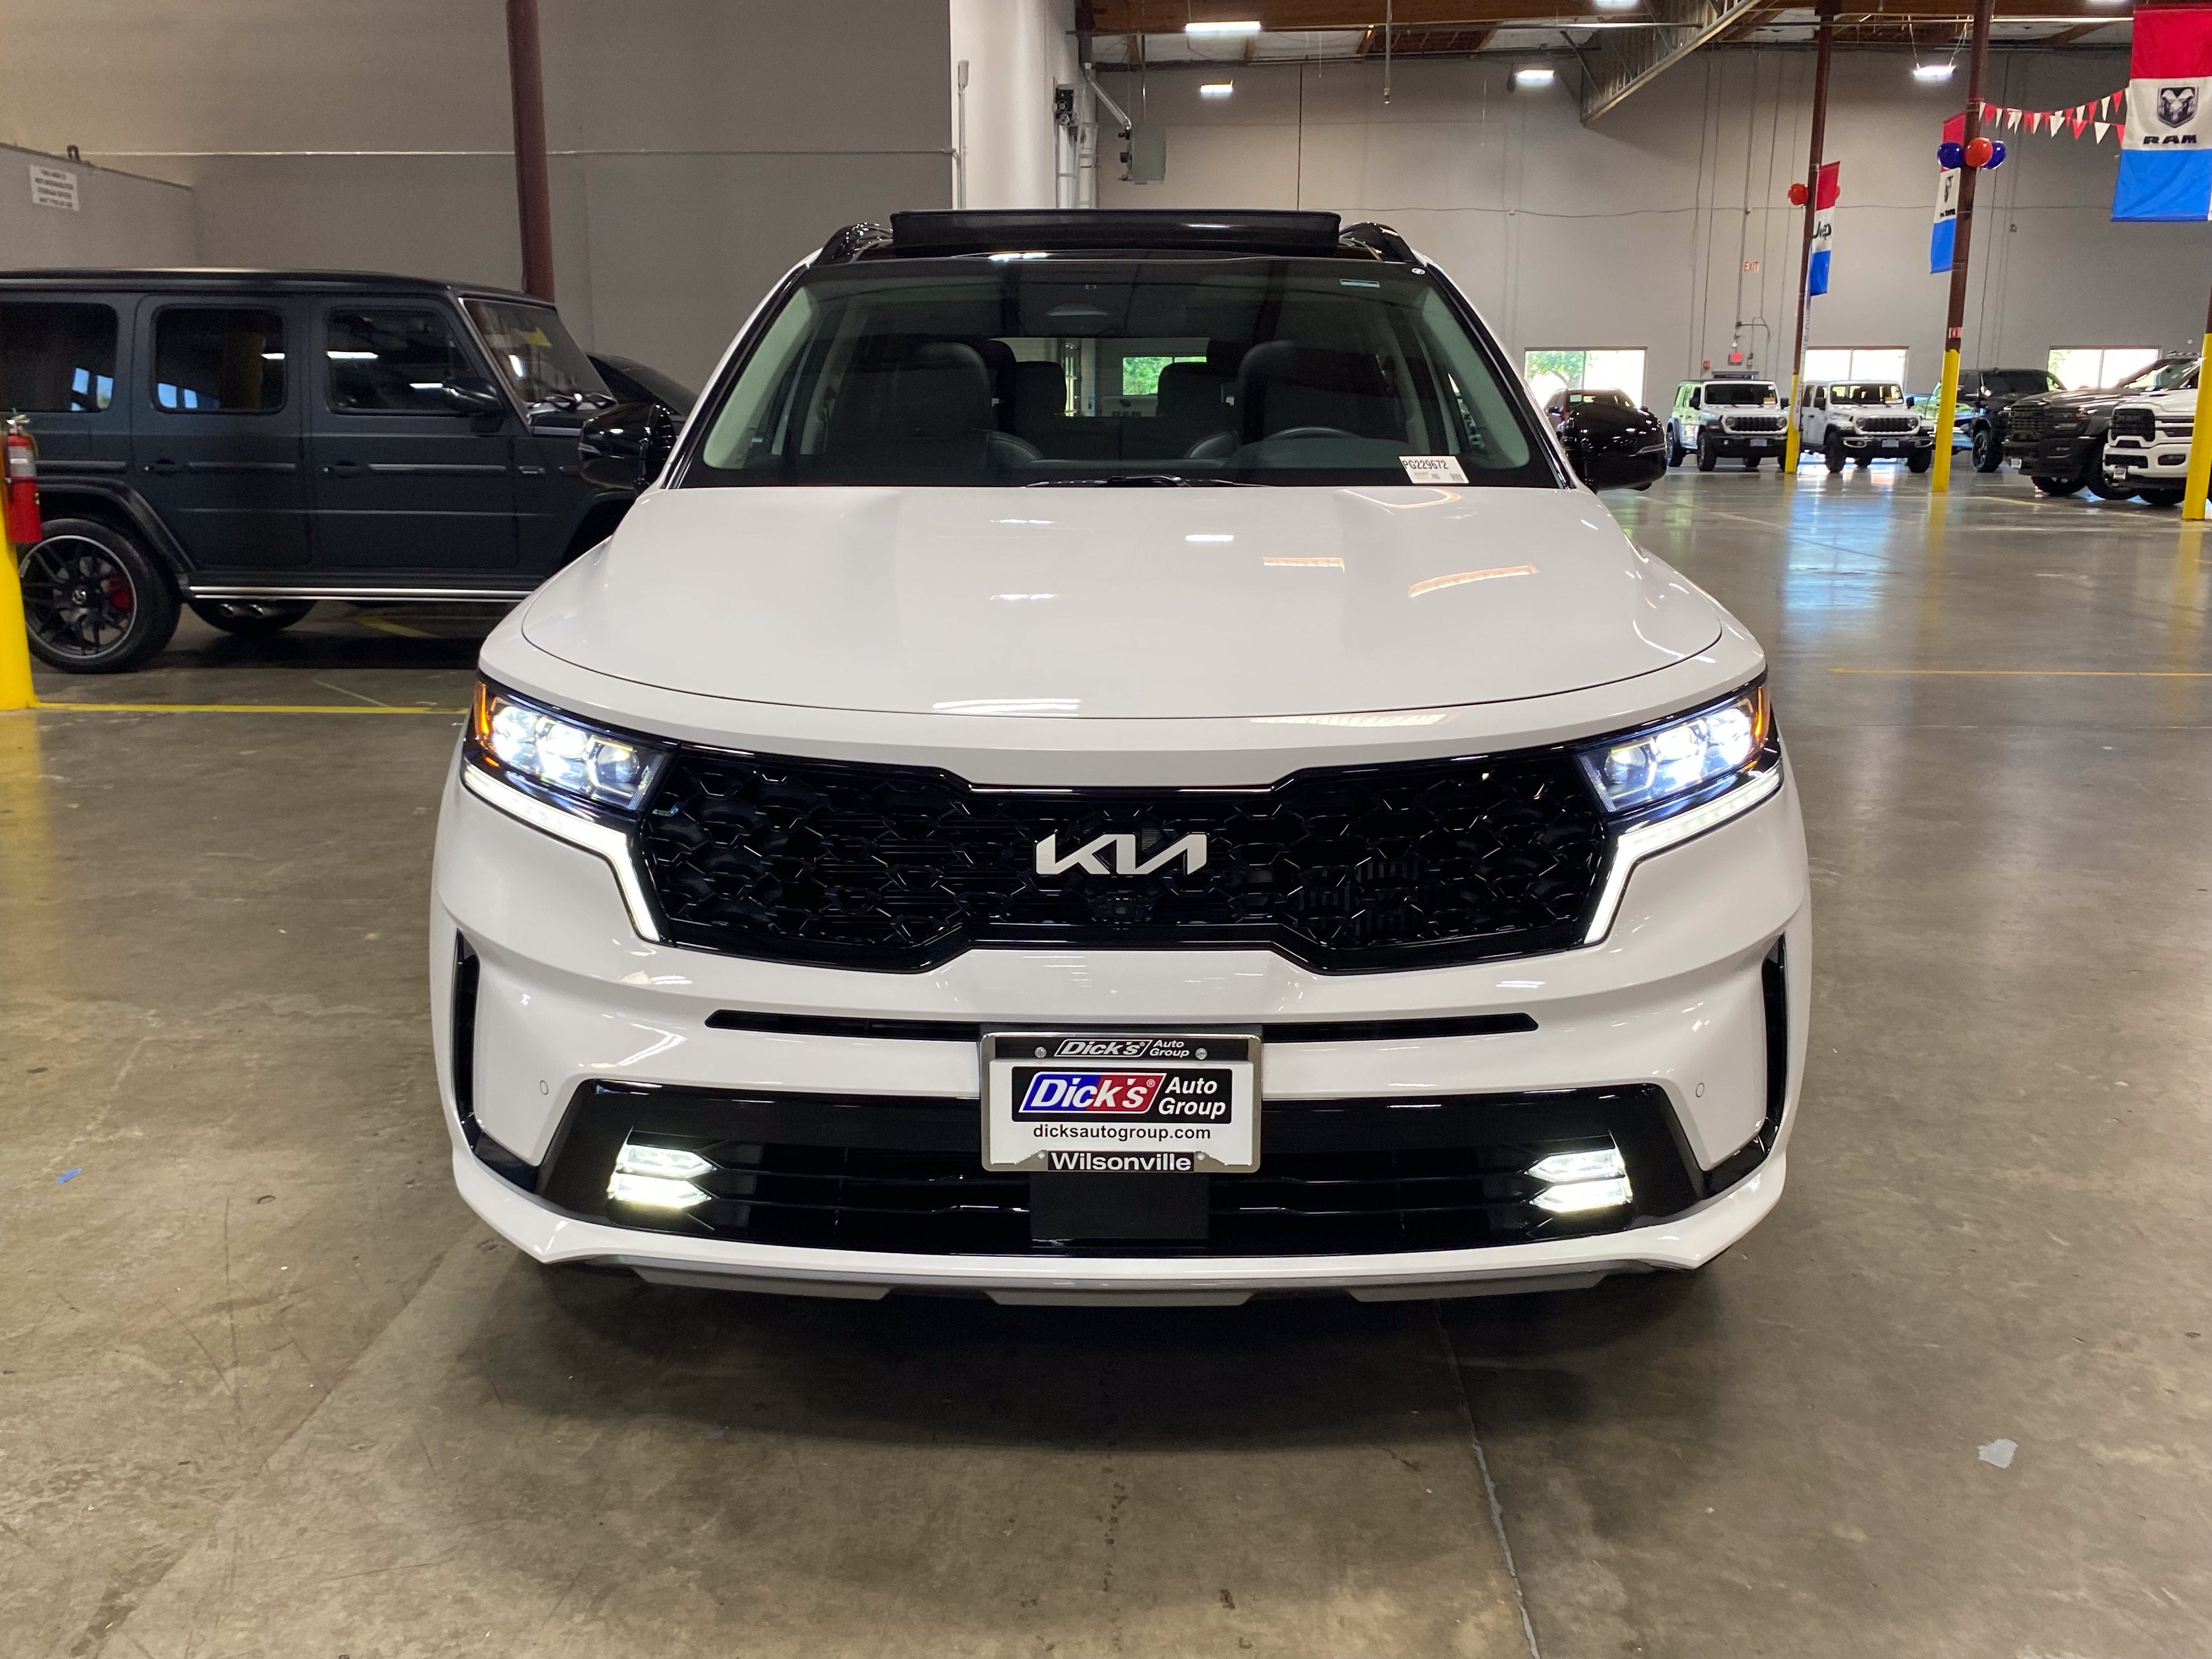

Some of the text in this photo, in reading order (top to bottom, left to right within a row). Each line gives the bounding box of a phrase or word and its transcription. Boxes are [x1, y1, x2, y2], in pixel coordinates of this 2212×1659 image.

[2143, 134, 2197, 145] RAM
[1744, 261, 1758, 272] EXIT
[1402, 460, 1449, 470] PG229672
[1036, 833, 1207, 876] KIA
[1060, 1041, 1141, 1055] Dick's
[1153, 1039, 1185, 1048] Auto
[1149, 1047, 1190, 1058] Group
[1030, 1077, 1148, 1109] Dick's
[1165, 1076, 1218, 1094] Auto
[1158, 1097, 1226, 1120] Group
[1033, 1124, 1211, 1142] dicksautogroup.com
[1051, 1152, 1192, 1171] Wilsonville
